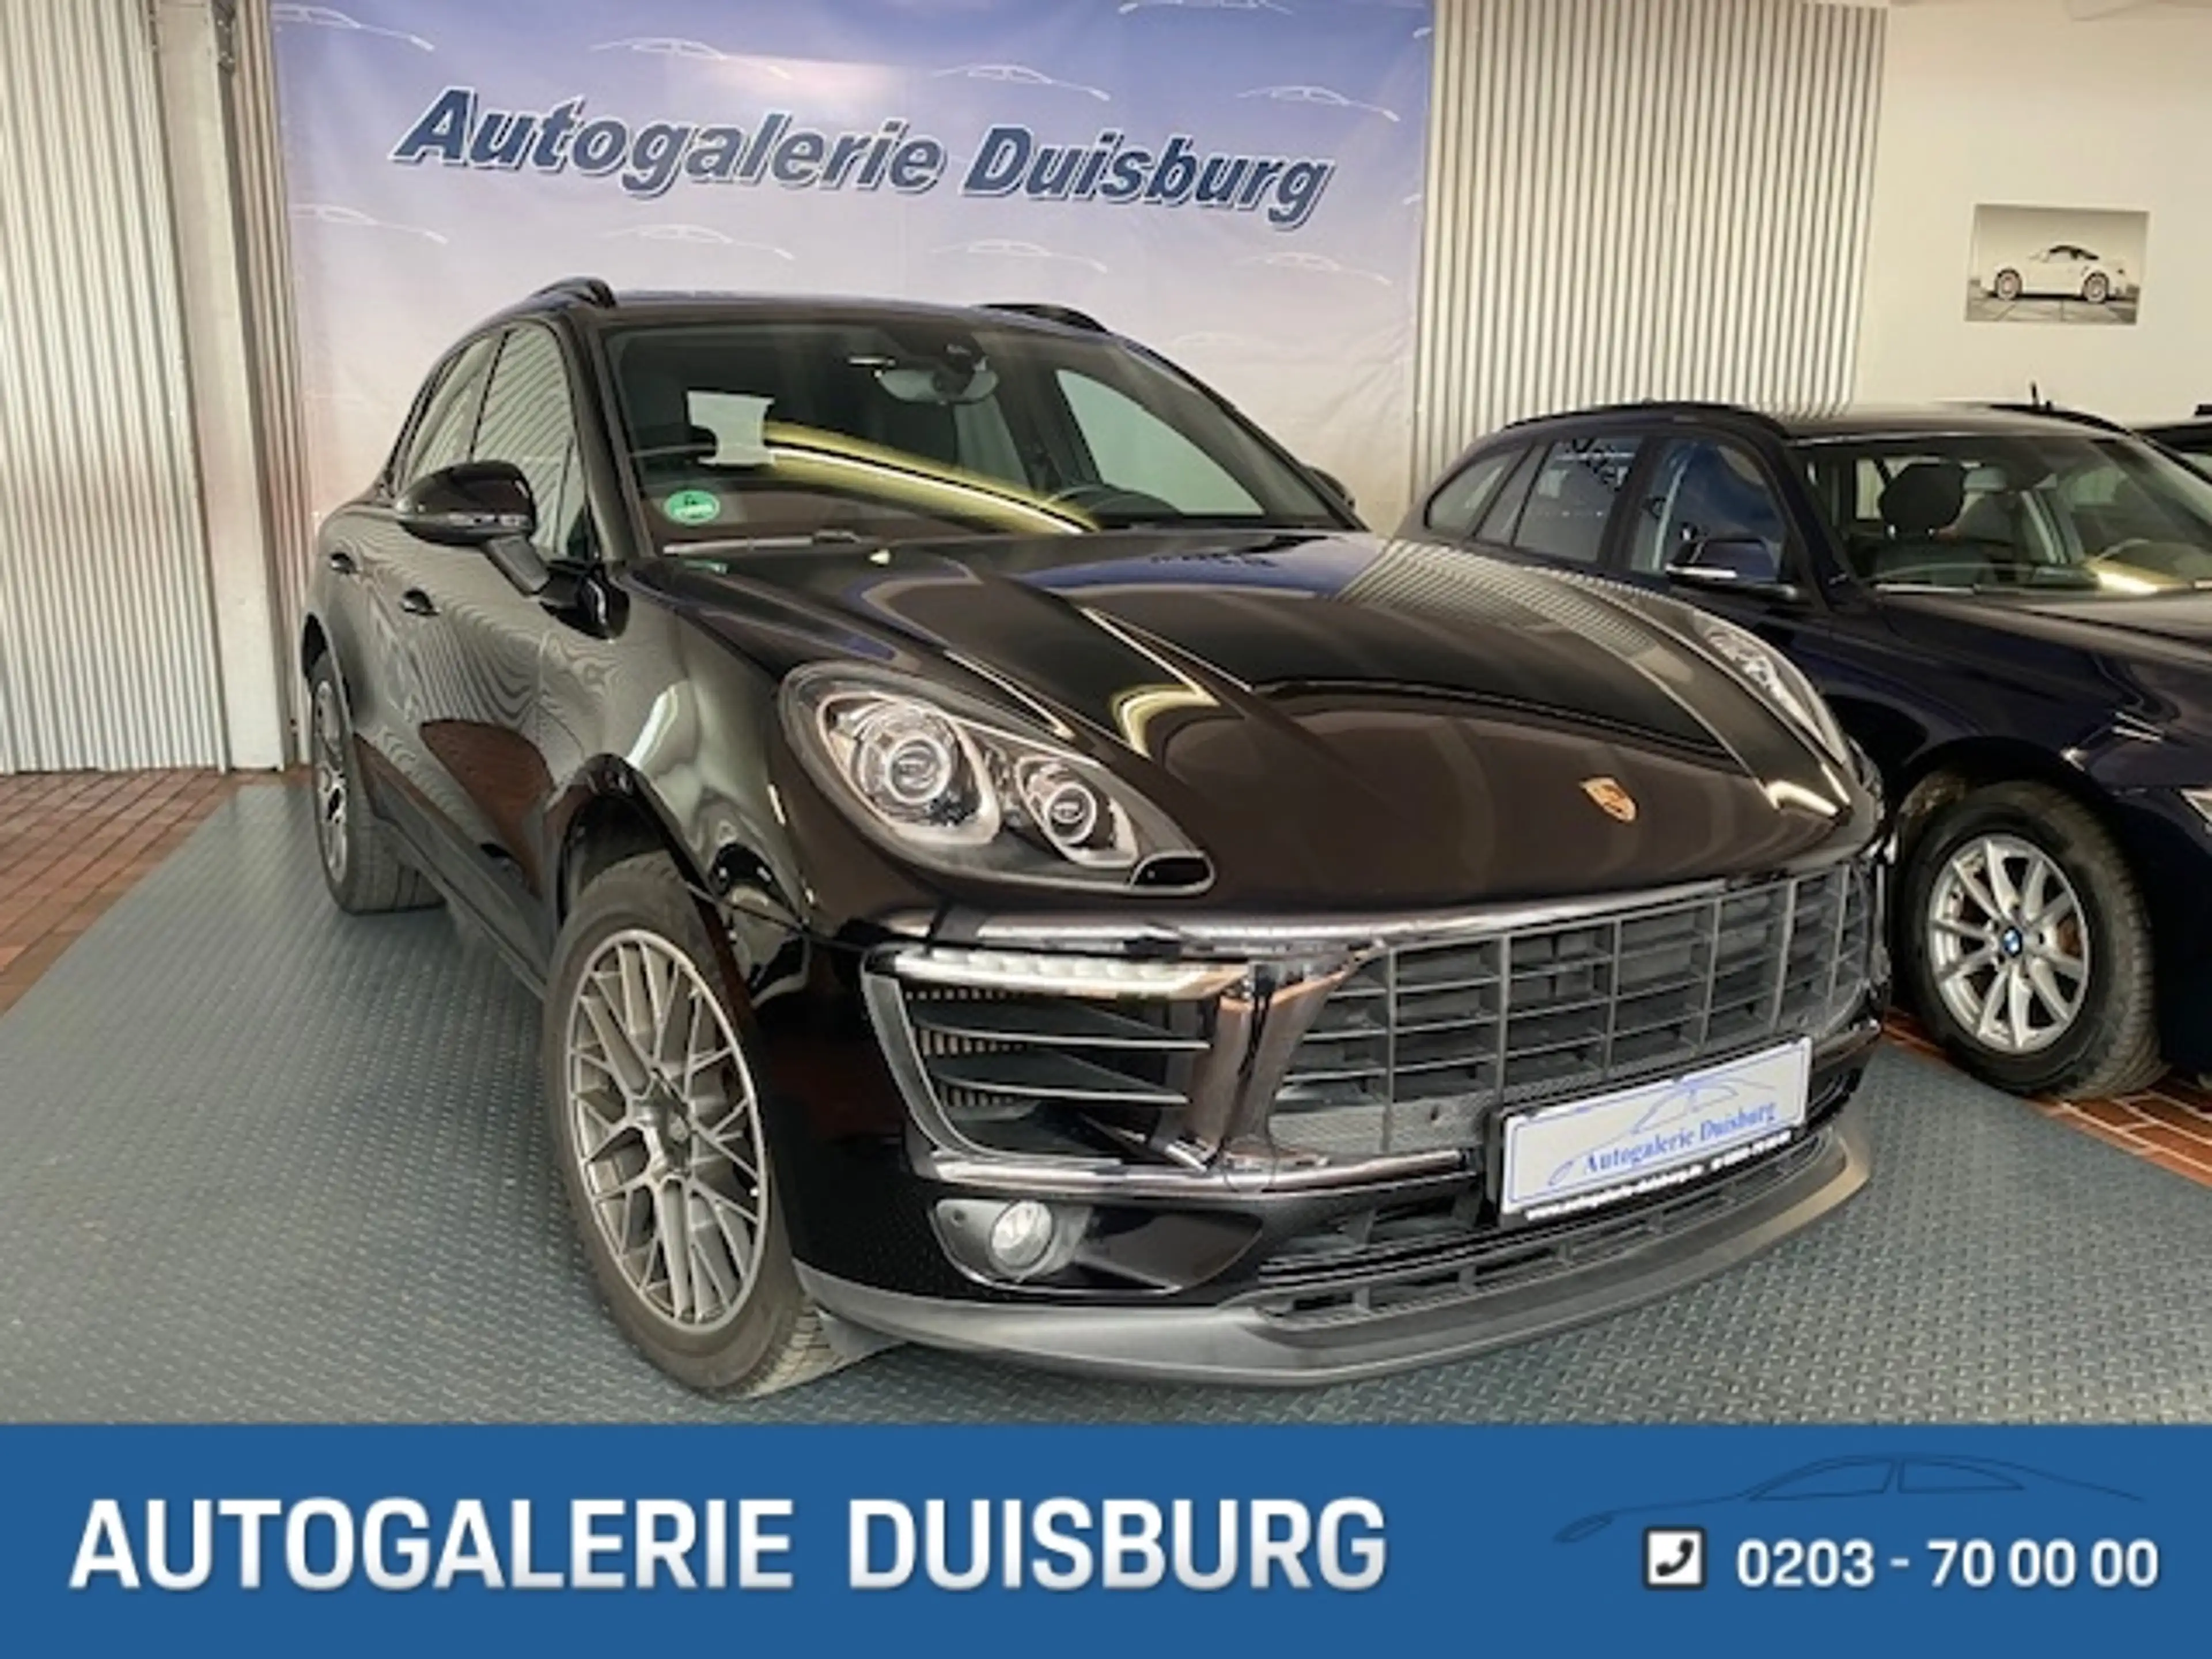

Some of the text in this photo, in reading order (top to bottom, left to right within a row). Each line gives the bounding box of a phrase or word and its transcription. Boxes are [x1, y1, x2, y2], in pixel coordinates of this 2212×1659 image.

[392, 86, 1335, 230] Autogalerie Duisburg
[1585, 1130, 1694, 1172] Autogalerie
[1700, 1102, 1775, 1141] Duisburg
